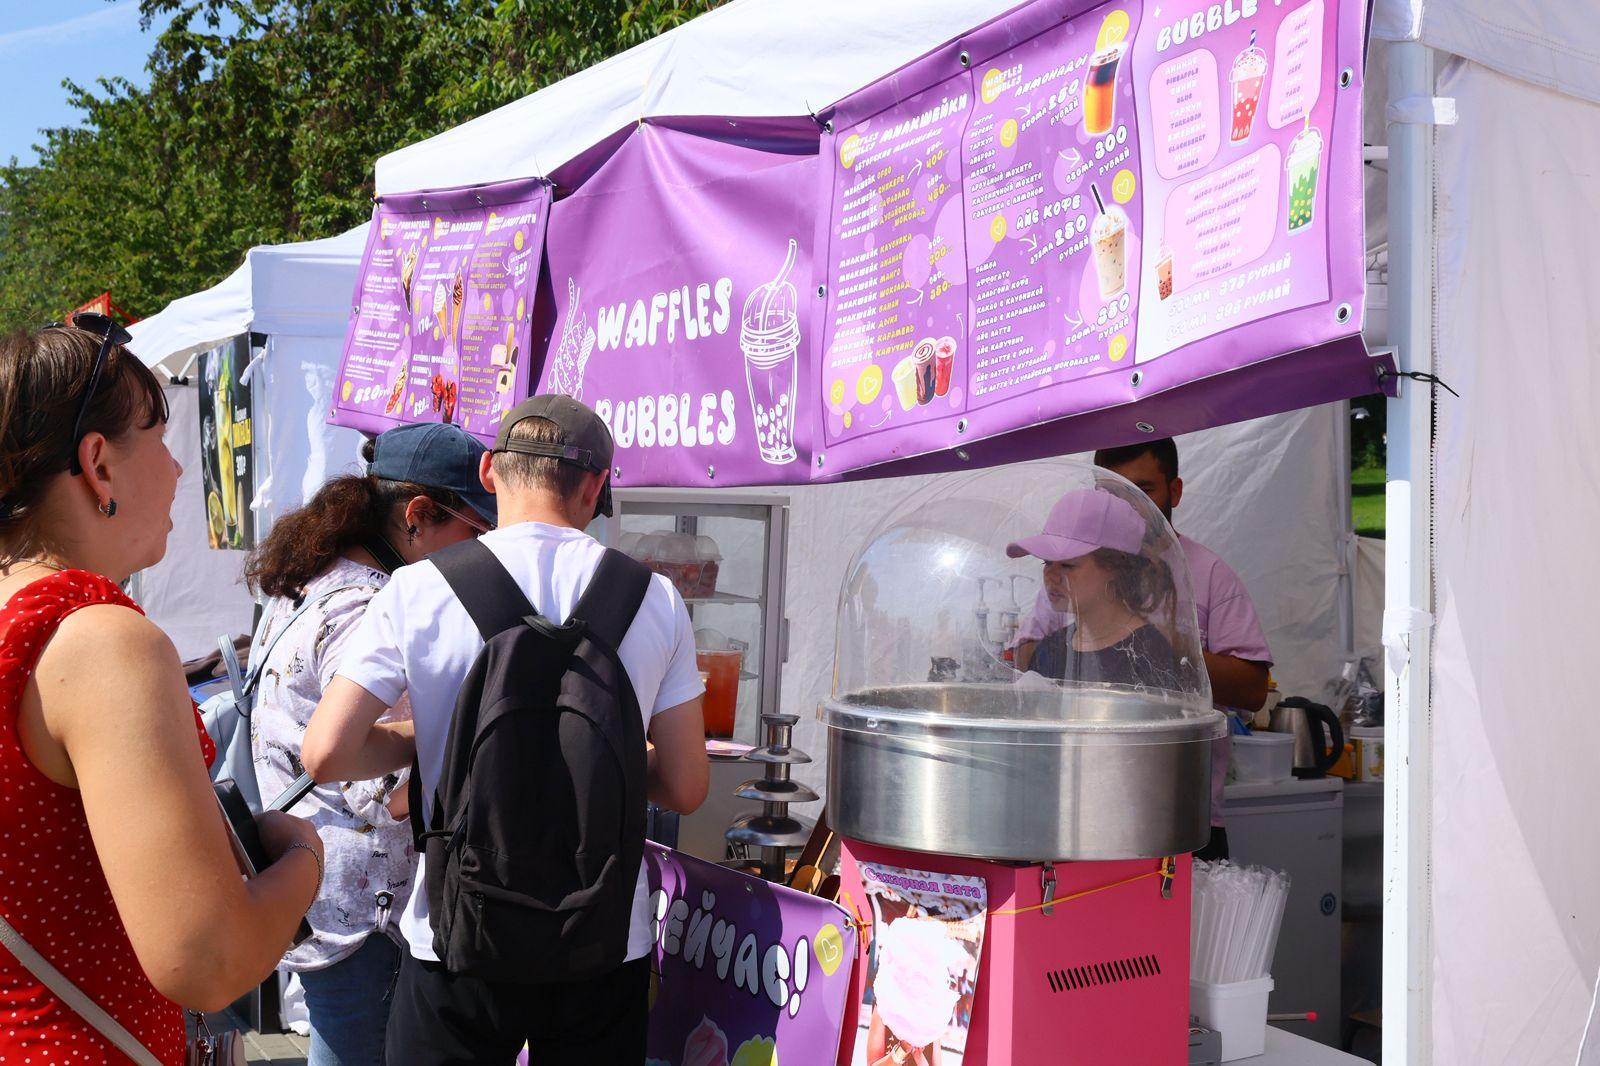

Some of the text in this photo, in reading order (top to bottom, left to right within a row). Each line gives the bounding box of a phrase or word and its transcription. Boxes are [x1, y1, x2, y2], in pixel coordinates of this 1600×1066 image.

[1156, 0, 1258, 52] BUBBLE
[986, 64, 1023, 87] WAFFLES
[1014, 54, 1089, 97] ЛИМОНАДЫ
[1166, 68, 1199, 85] PINEAPPLE
[1050, 96, 1079, 126] РУБЛЕЙ
[1176, 93, 1192, 104] BLUE
[880, 93, 968, 143] МИЛКШЕЙКИ
[1095, 125, 1127, 160] 300
[970, 163, 996, 179] МОХИТО
[1005, 162, 1033, 180] МОХИТО
[1098, 146, 1130, 176] РУБЛЕЙ
[1177, 158, 1199, 171] MANGO
[843, 174, 876, 197] МИЛКШЕЙК
[843, 175, 905, 212] МИЛКШЕЙК СНИКЕРС
[1014, 172, 1042, 190] МОХИТО
[1012, 186, 1044, 204] ЛИМОНОМ
[841, 205, 878, 226] МИЛКШЕЙК
[1016, 194, 1081, 231] АЙС КОФЕ
[840, 219, 879, 240] МИЛКШЕЙК
[1054, 213, 1087, 247] 250
[839, 233, 913, 269] МИЛКШЕЙК КЛУБНИКА
[1058, 235, 1089, 263] РУБЛЕЙ
[838, 252, 903, 283] МИЛКШЕЙК АНАНАС
[1247, 252, 1292, 282] РУБЛЕЙ
[837, 280, 913, 311] МИЛКШЕЙК ШОКОЛАД
[838, 268, 902, 297] МИЛКШЕЙК МАНГО
[1011, 277, 1029, 291] КОФЕ
[1244, 278, 1292, 310] РУБЛЕЙ
[835, 299, 900, 326] МИЛКШЕЙК БАНАН
[976, 302, 998, 315] КАКАО
[1005, 284, 1044, 310] КЛУБНИКОЙ
[1097, 293, 1130, 325] 350
[598, 277, 732, 351] WAFFLES
[976, 315, 998, 329] КАКАО
[1005, 300, 1046, 319] КАРАМЕЛЬЮ
[1098, 313, 1130, 342] РУБЛЕЙ
[834, 321, 876, 339] МИЛКШЕЙК
[976, 325, 1012, 342] АЙС ЛАТТЕ
[832, 336, 875, 354] МИЛКШЕЙК
[976, 345, 989, 356] АЙС
[976, 359, 989, 370] АЙС
[990, 353, 1011, 366] ЛАТТЕ
[1018, 346, 1034, 357] ОРЕО
[831, 351, 873, 368] МИЛКШЕЙК
[976, 372, 988, 383] АЙС
[990, 367, 1010, 380] ЛАТТЕ
[865, 867, 940, 893] Сахарная
